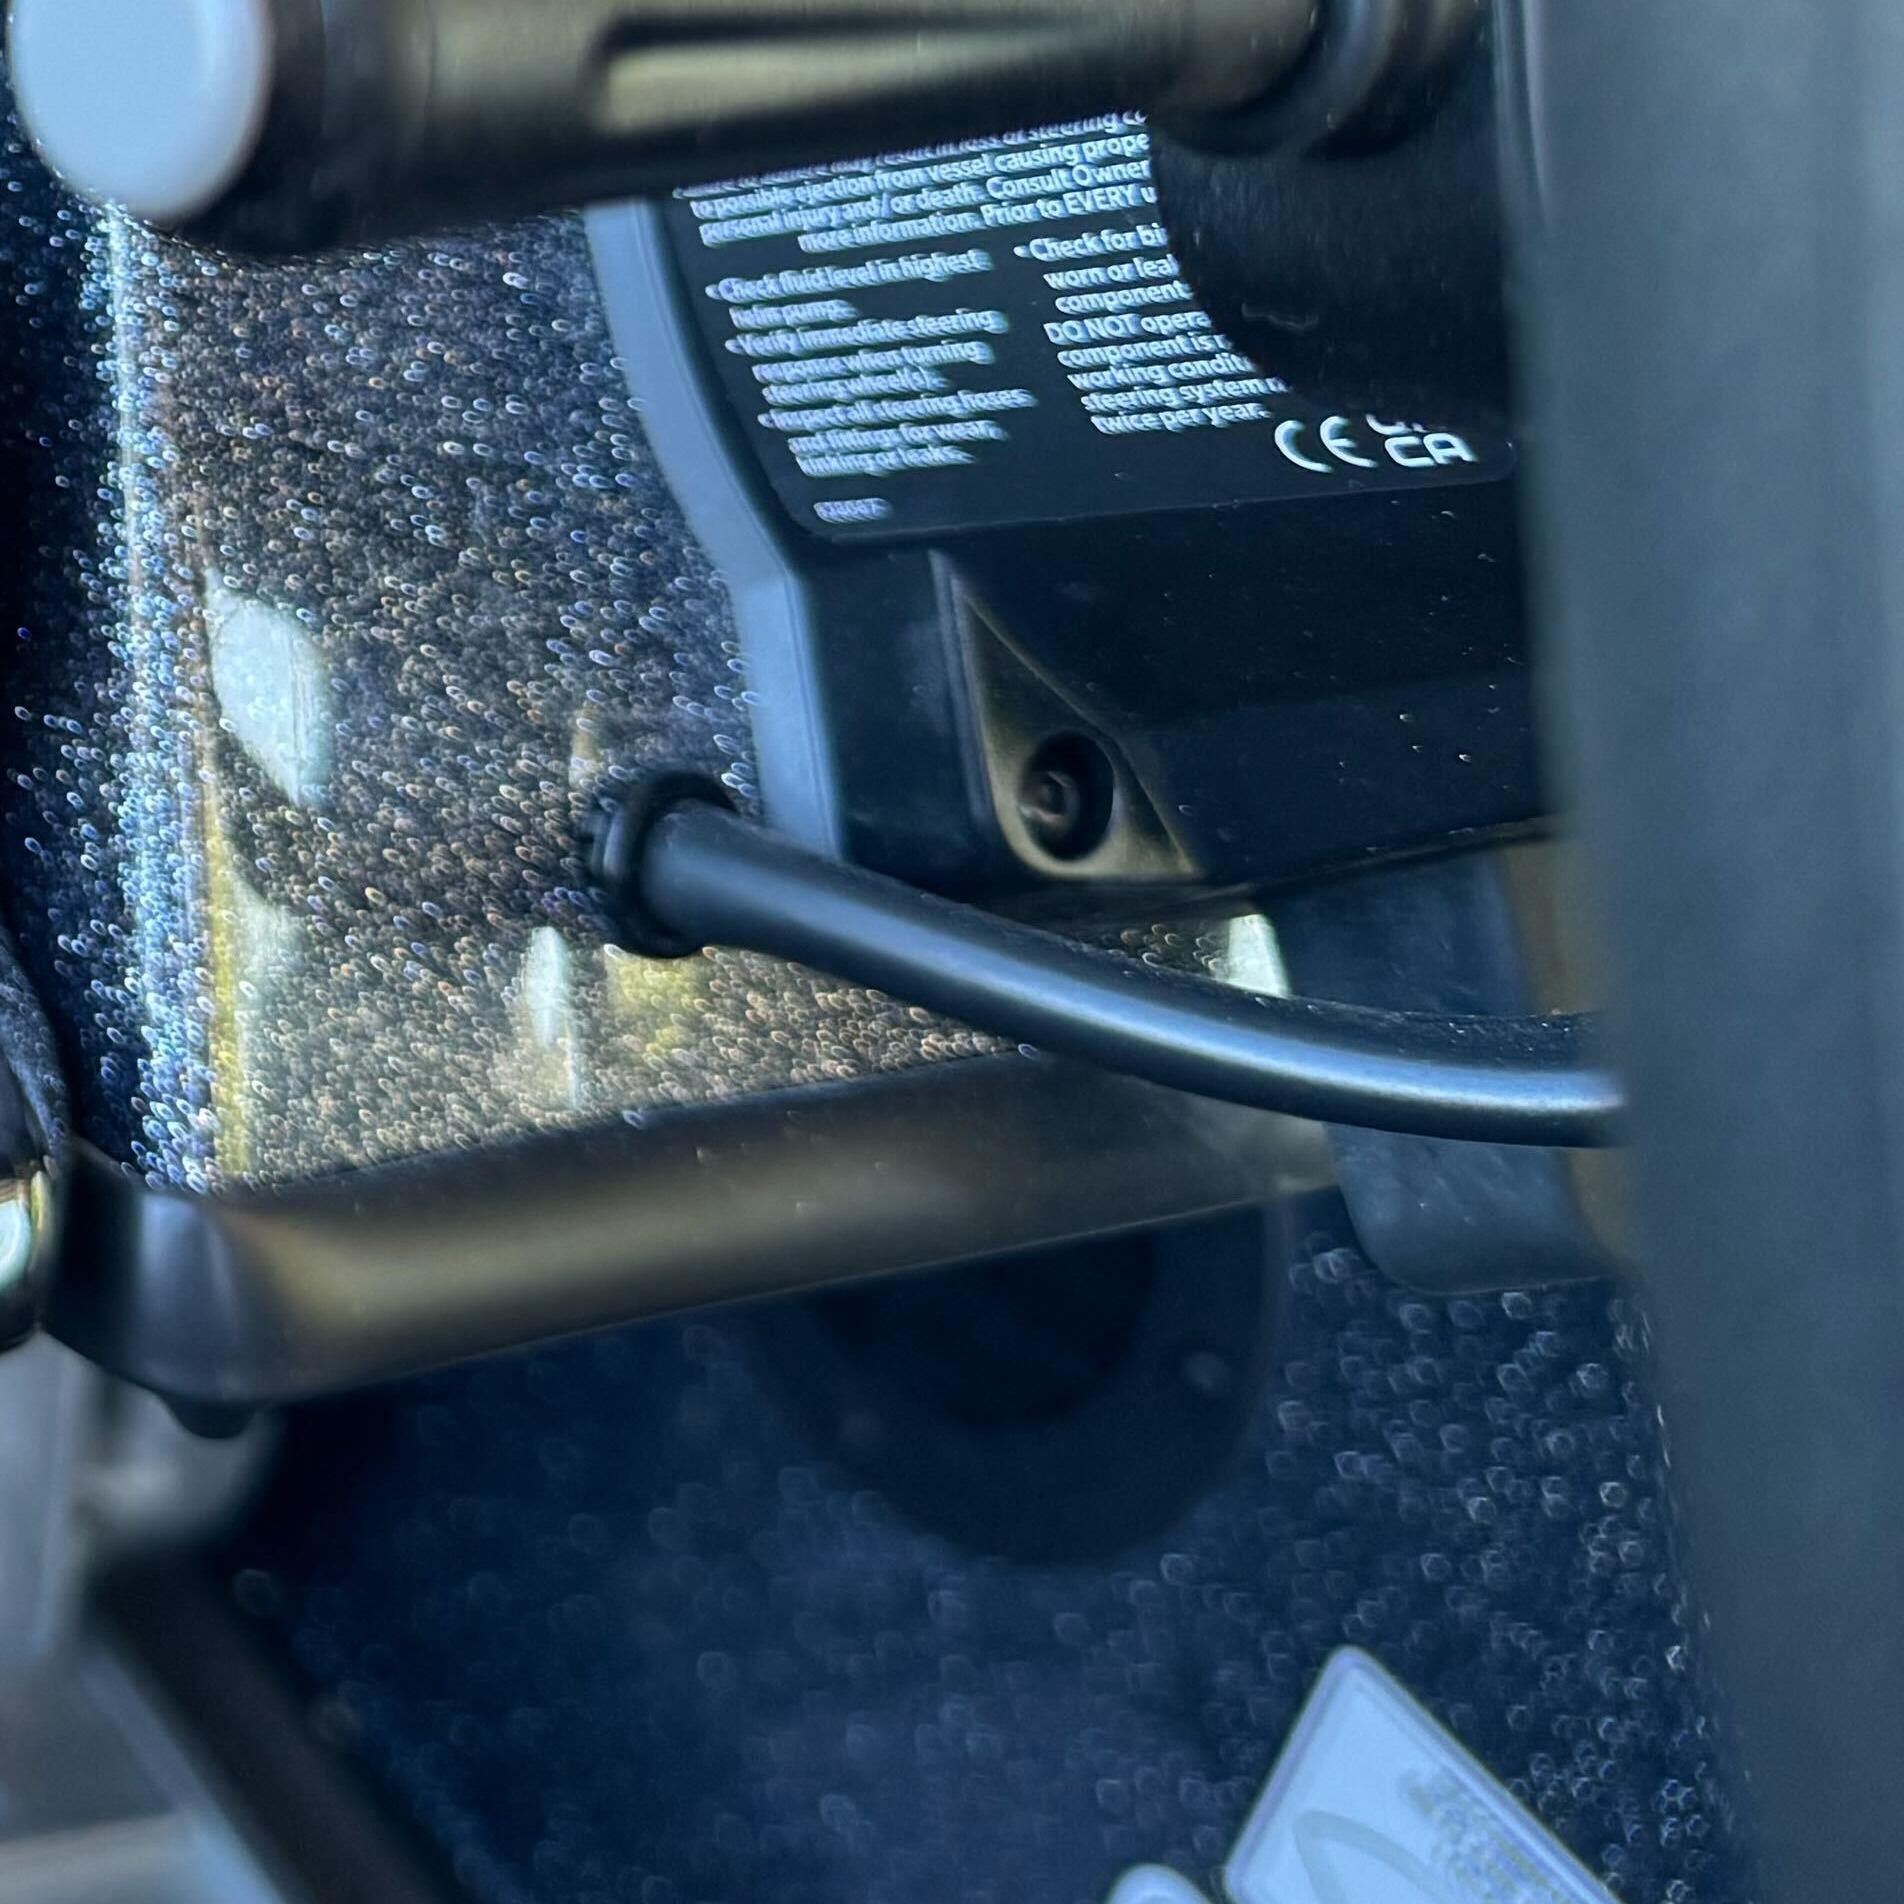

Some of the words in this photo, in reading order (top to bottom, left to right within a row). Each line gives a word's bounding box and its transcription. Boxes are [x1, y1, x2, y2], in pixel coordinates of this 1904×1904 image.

[715, 187, 794, 219] possible
[793, 176, 875, 211] ejection
[875, 168, 929, 192] from
[994, 143, 1082, 173] causing
[986, 168, 1074, 200] Consult
[980, 201, 1039, 227] Prior
[1035, 198, 1068, 219] to
[1063, 184, 1141, 216] EVERY
[1029, 232, 1104, 263] Check
[1100, 228, 1141, 254] for
[718, 273, 780, 304] Check
[825, 259, 877, 290] level
[899, 248, 994, 282] highest
[1043, 267, 1109, 291] worn
[1106, 263, 1138, 284] or
[906, 308, 1009, 340] steering
[1043, 319, 1090, 345] DO
[1083, 313, 1144, 340] NOT
[1057, 335, 1193, 369] component
[1067, 363, 1173, 391] working
[1080, 385, 1185, 413] steering
[1178, 377, 1267, 407] system
[1090, 410, 1164, 435] twice
[1158, 406, 1210, 433] per
